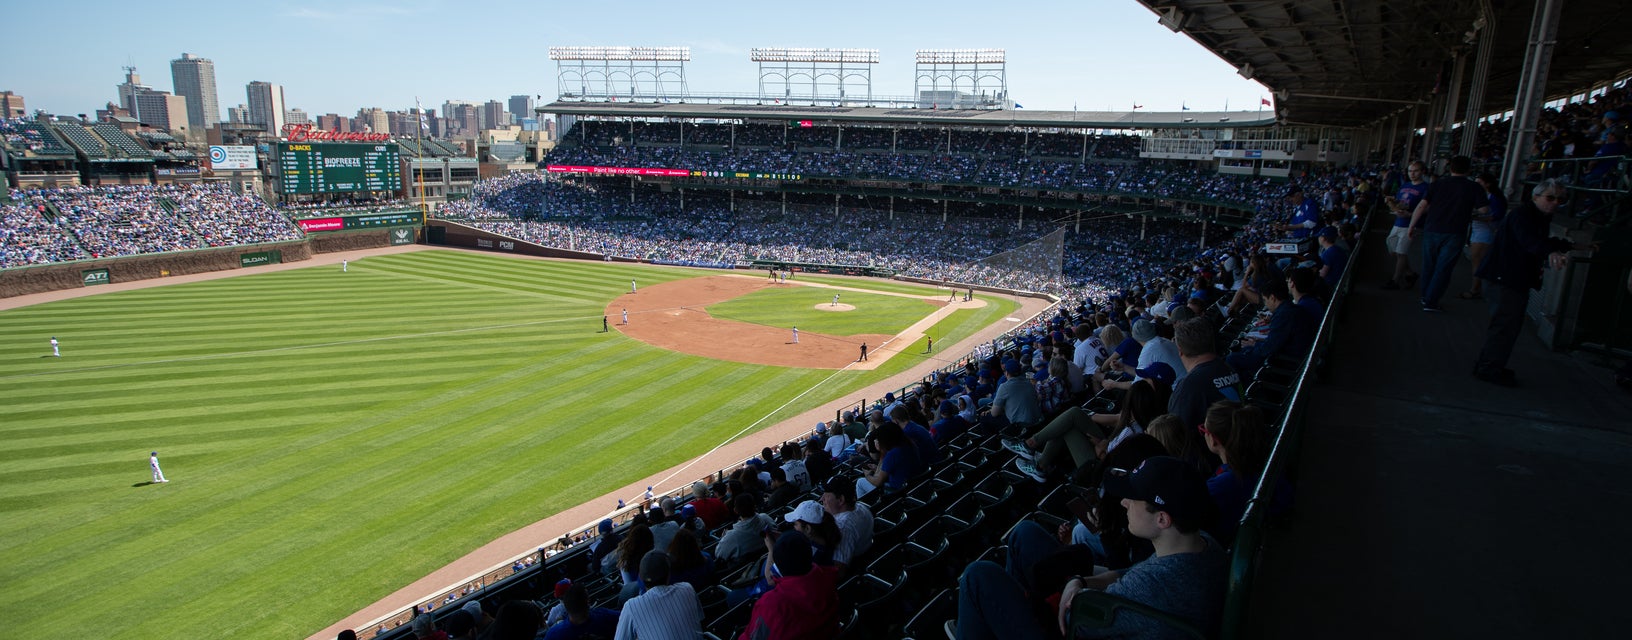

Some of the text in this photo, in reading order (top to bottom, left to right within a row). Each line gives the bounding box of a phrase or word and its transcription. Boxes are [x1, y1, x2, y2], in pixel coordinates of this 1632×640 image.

[282, 124, 390, 141] Budweiser
[500, 241, 514, 250] PCM
[84, 272, 108, 280] ATI
